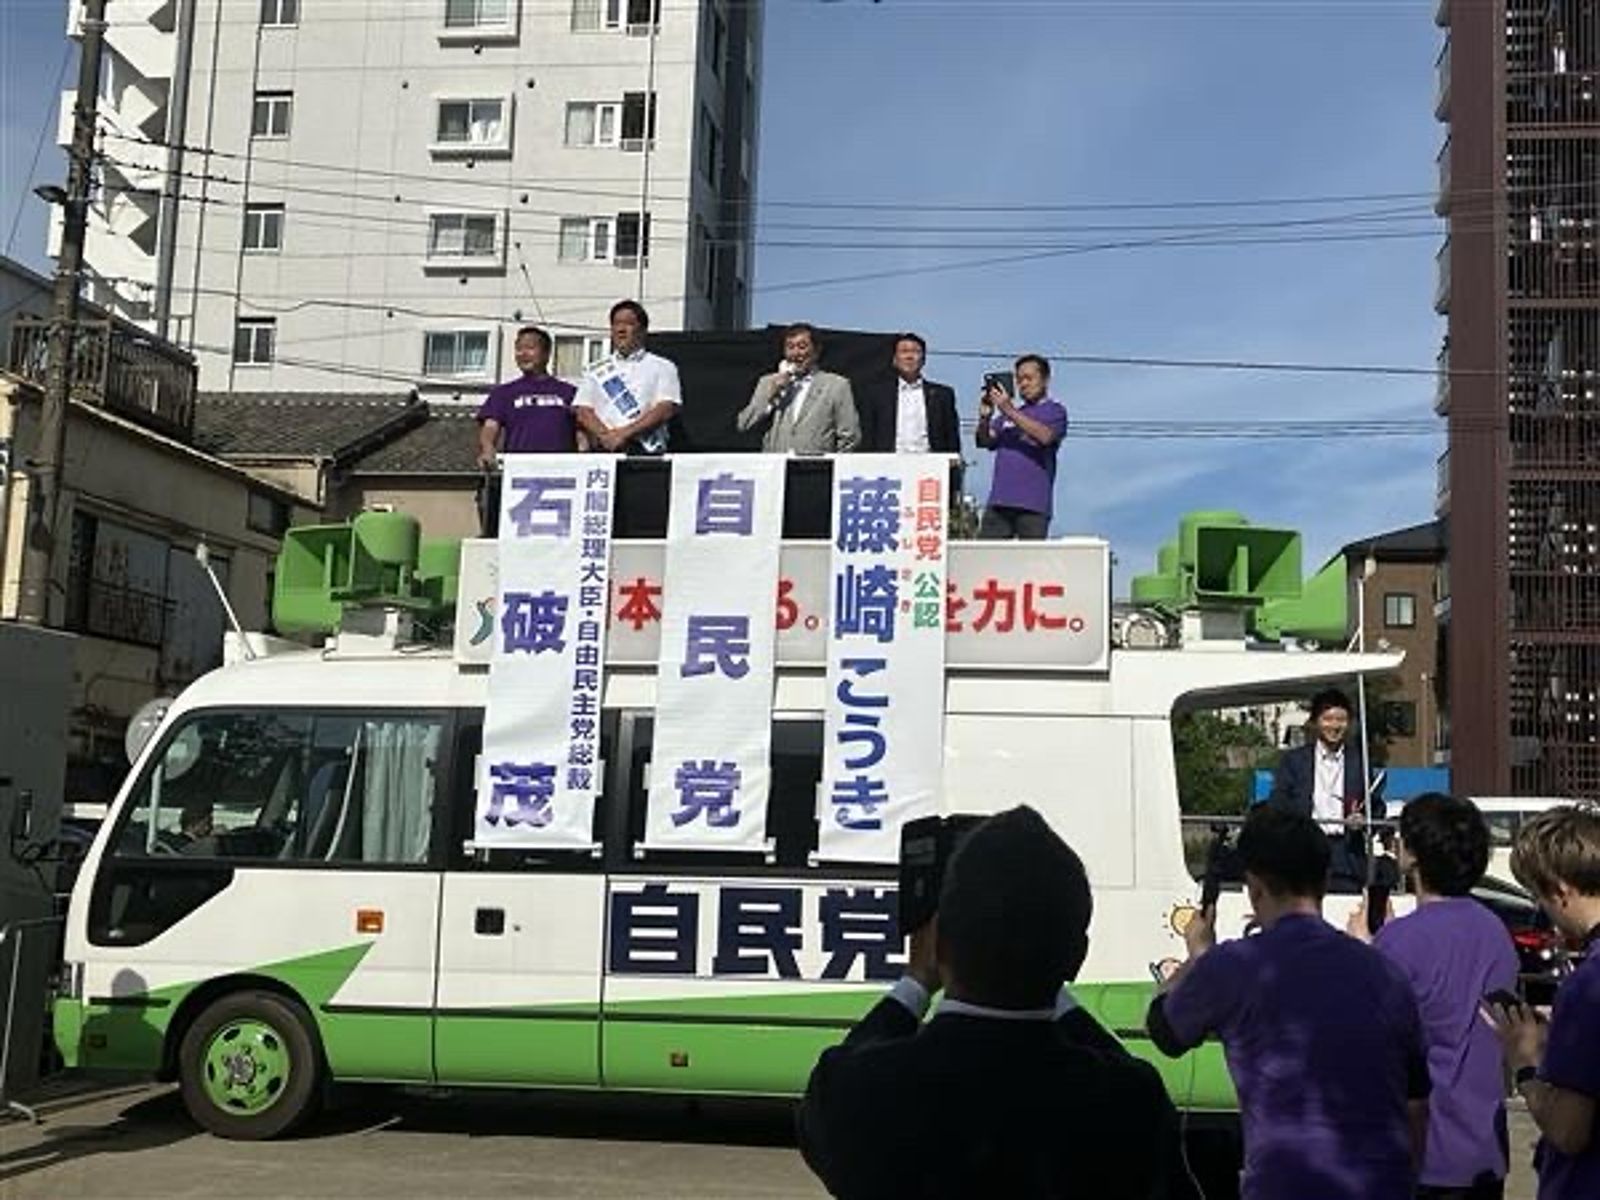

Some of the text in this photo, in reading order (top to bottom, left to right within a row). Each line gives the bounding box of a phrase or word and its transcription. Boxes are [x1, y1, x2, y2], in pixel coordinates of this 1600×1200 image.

[485, 477, 577, 828] 石破茂
[670, 473, 756, 828] 自民党
[831, 477, 902, 830] 藤崎こうき
[914, 478, 942, 628] 自民党 公認
[610, 884, 906, 980] 自民党
